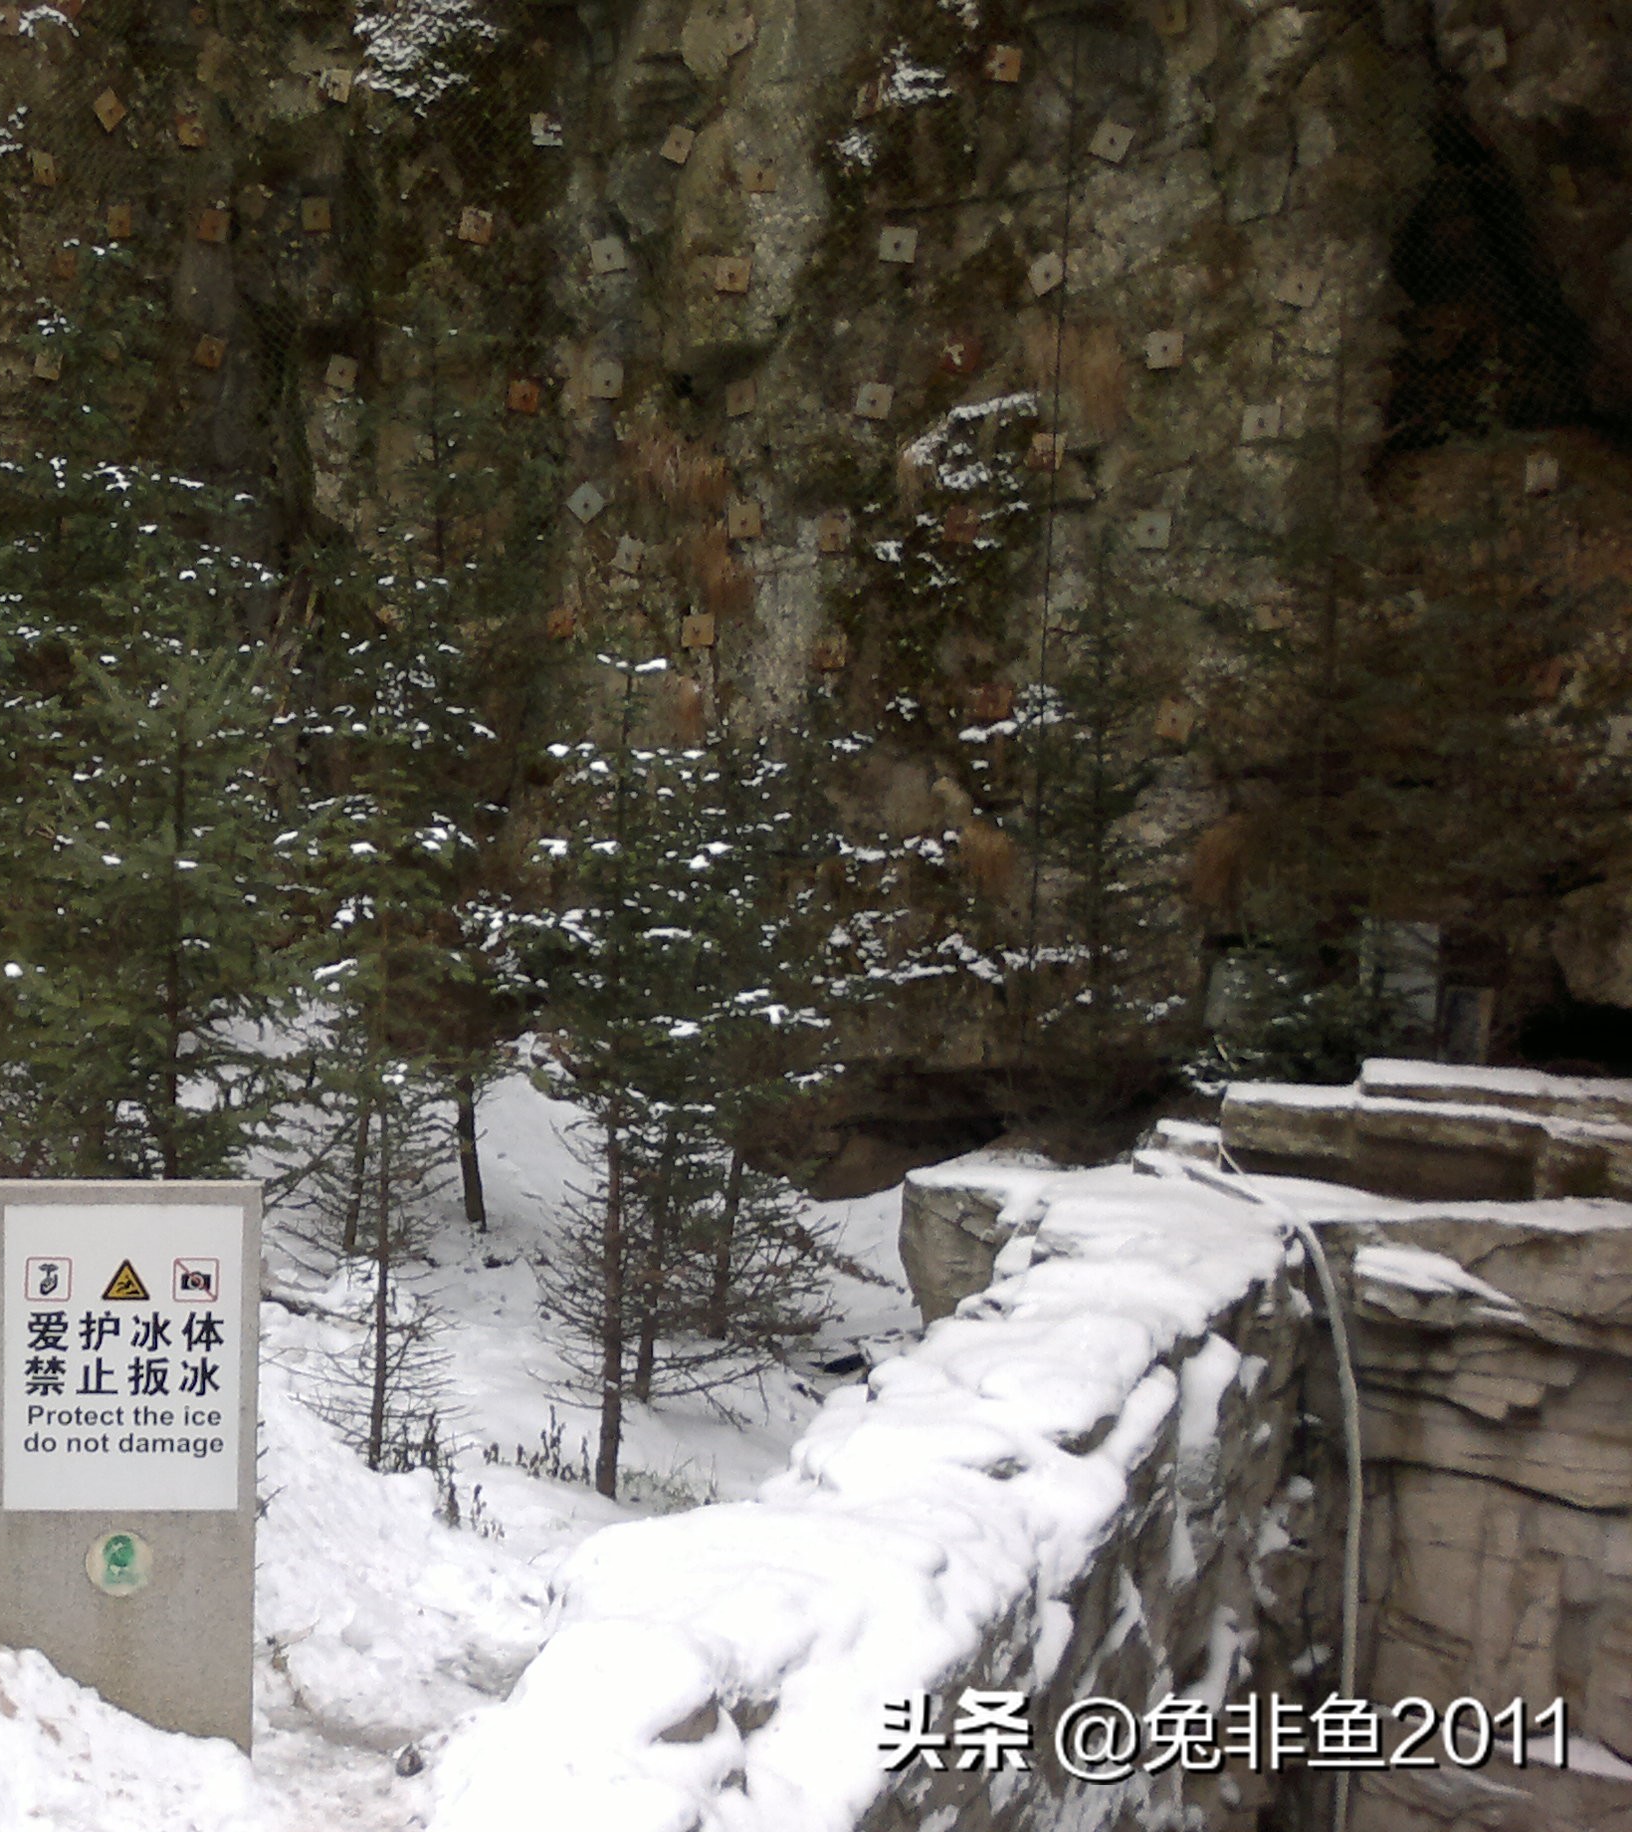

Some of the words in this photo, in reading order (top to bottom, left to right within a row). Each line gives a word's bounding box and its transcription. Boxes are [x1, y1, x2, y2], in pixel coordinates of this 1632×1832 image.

[27, 1310, 224, 1352] 爱护冰体
[24, 1356, 220, 1396] 禁止扳冰
[27, 1405, 124, 1426] Protect
[133, 1405, 175, 1426] the
[183, 1406, 222, 1426] ice
[23, 1433, 57, 1452] do
[66, 1434, 110, 1452] not
[118, 1433, 225, 1458] damage
